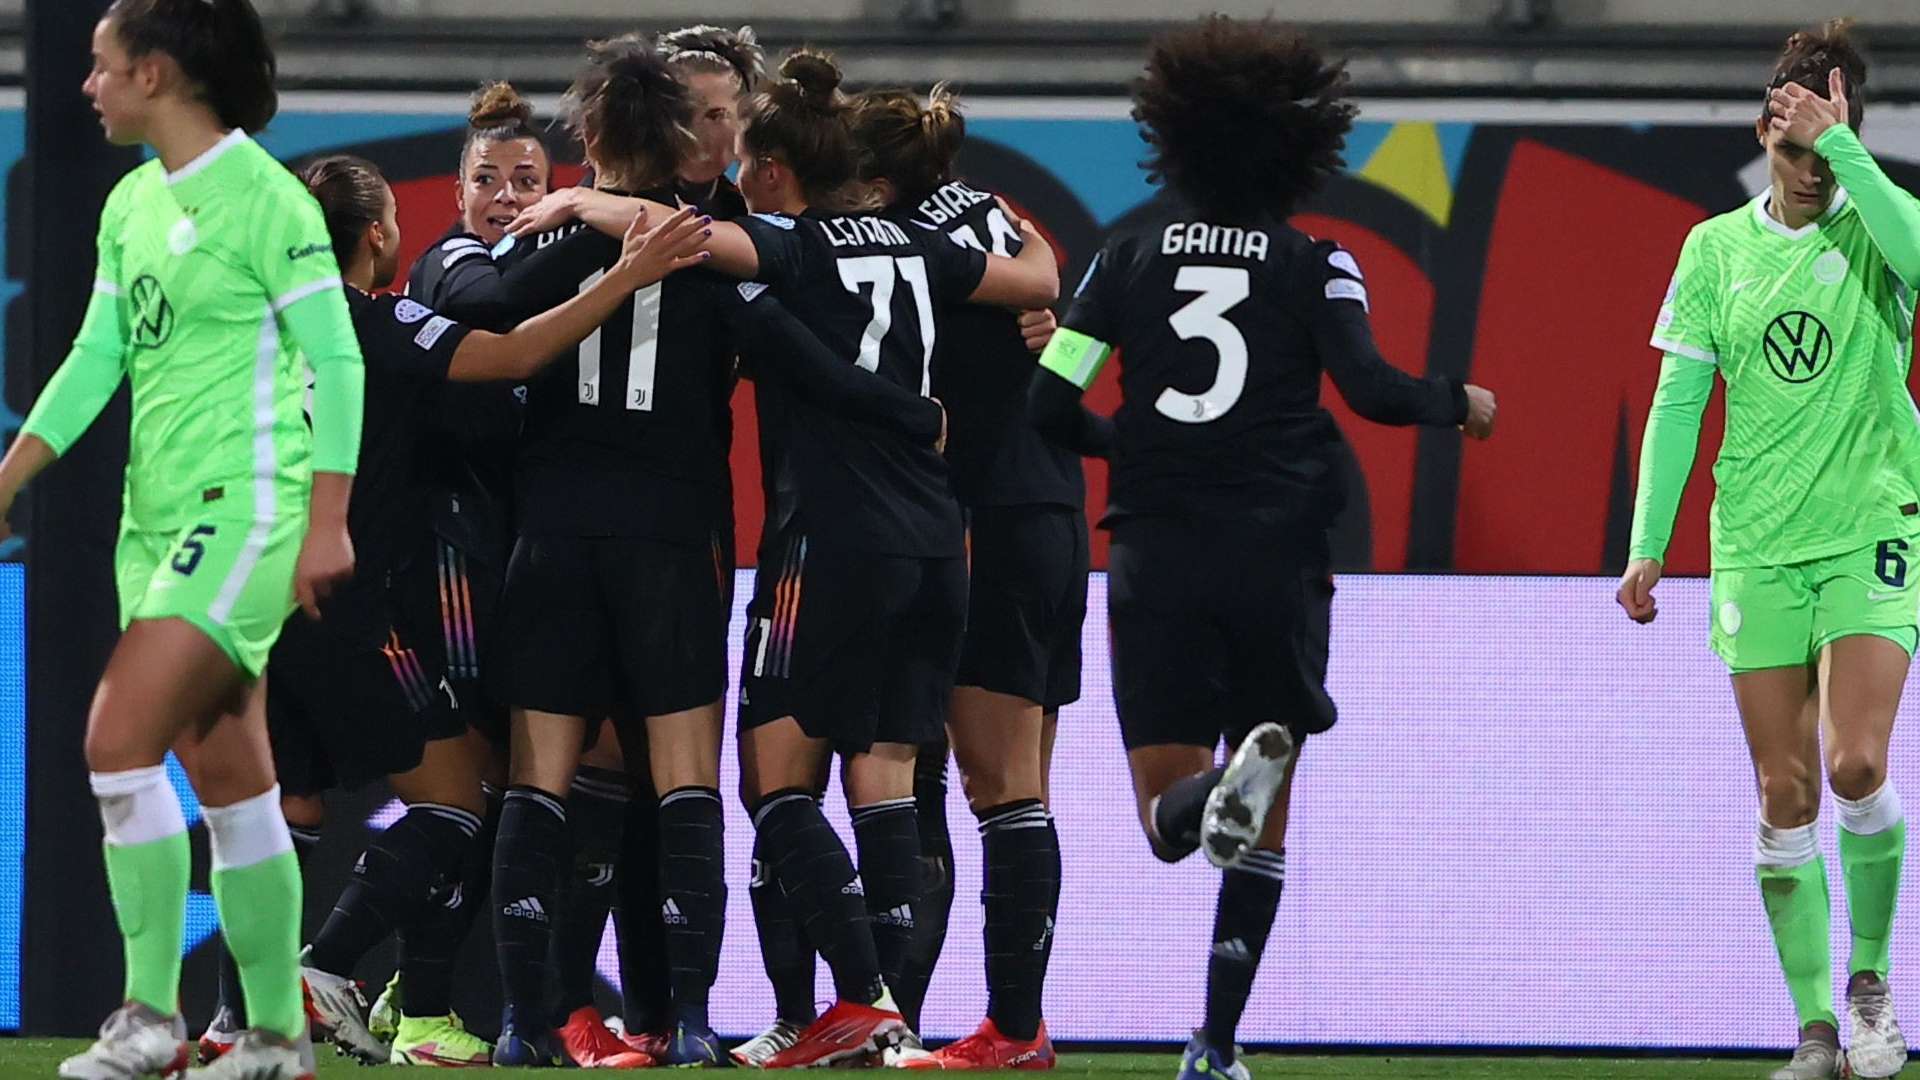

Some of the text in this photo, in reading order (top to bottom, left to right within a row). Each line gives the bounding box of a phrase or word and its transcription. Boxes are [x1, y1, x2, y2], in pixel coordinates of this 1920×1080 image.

[1161, 222, 1269, 262] GAMA
[578, 266, 663, 412] 11
[836, 255, 936, 399] 71
[1155, 266, 1249, 423] 3
[1763, 311, 1832, 383] VW
[171, 524, 216, 577] 5
[1874, 538, 1909, 588] 6
